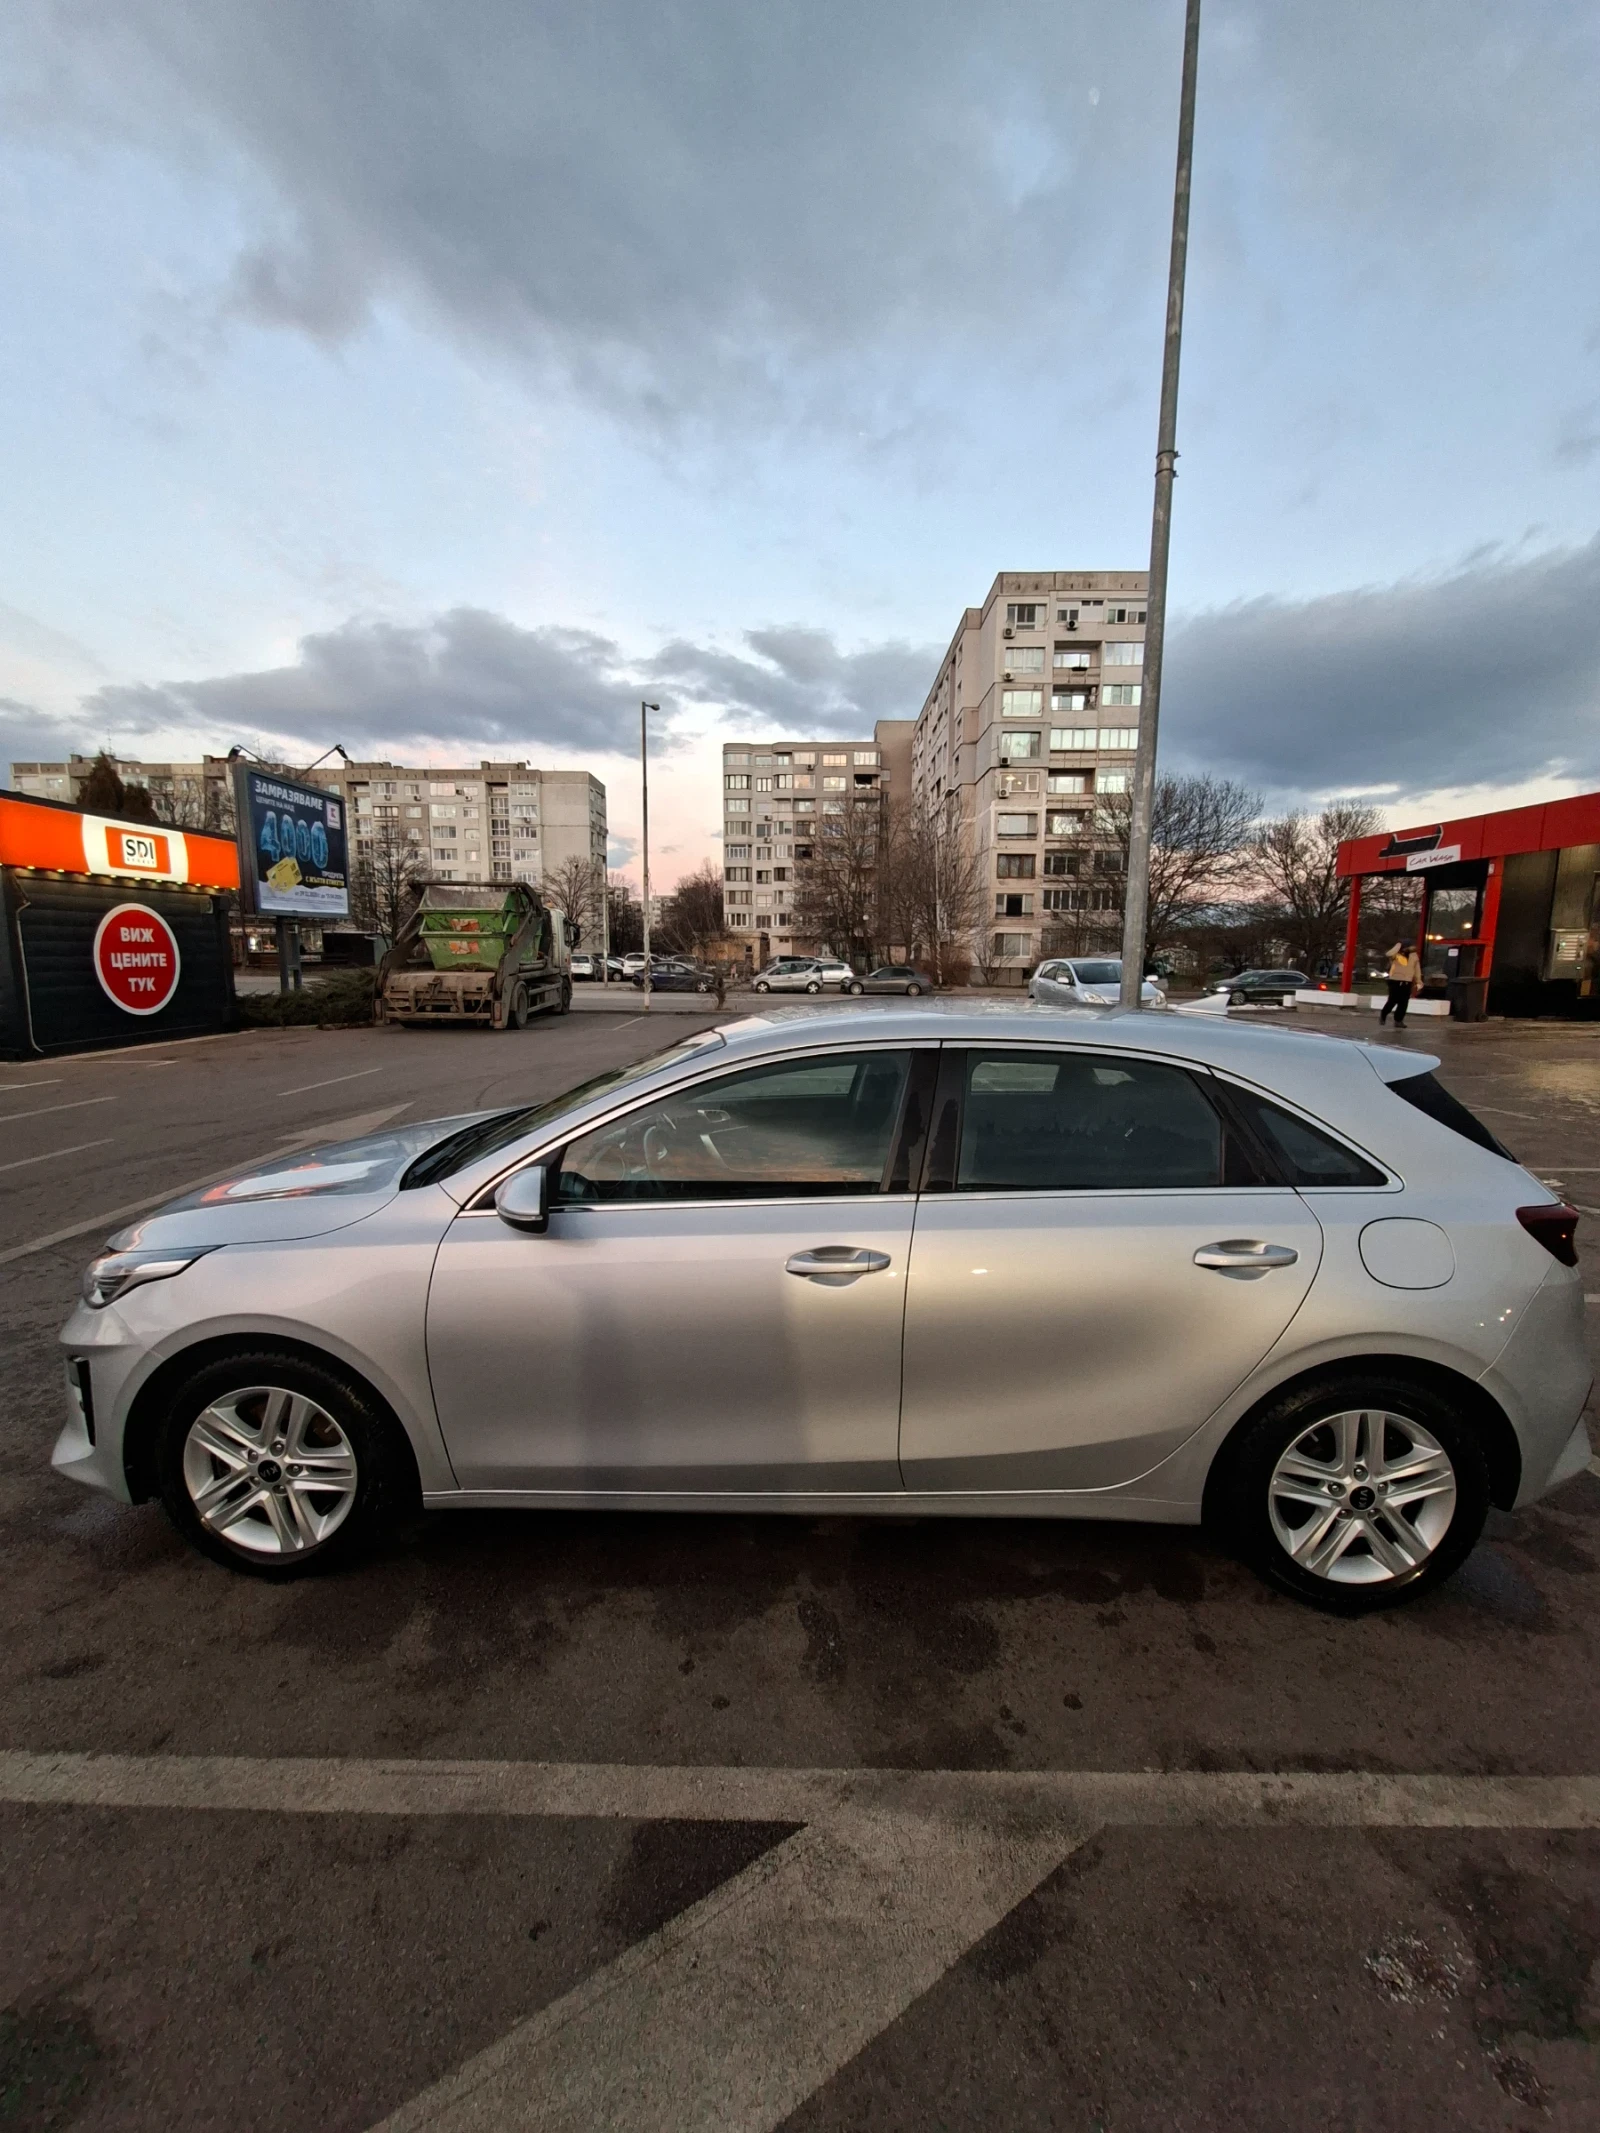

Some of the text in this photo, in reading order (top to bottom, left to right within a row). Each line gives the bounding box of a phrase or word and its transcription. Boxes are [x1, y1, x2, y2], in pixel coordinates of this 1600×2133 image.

[255, 780, 323, 810] ЗАМРАЗЯВАМЕ
[255, 795, 275, 806] ЦЕНИТЕ
[260, 810, 328, 868] 4000
[125, 839, 154, 859] SDI
[120, 927, 155, 942] ВИЖ
[110, 952, 167, 970] ЦЕНИТЕ
[127, 977, 156, 992] ТУК
